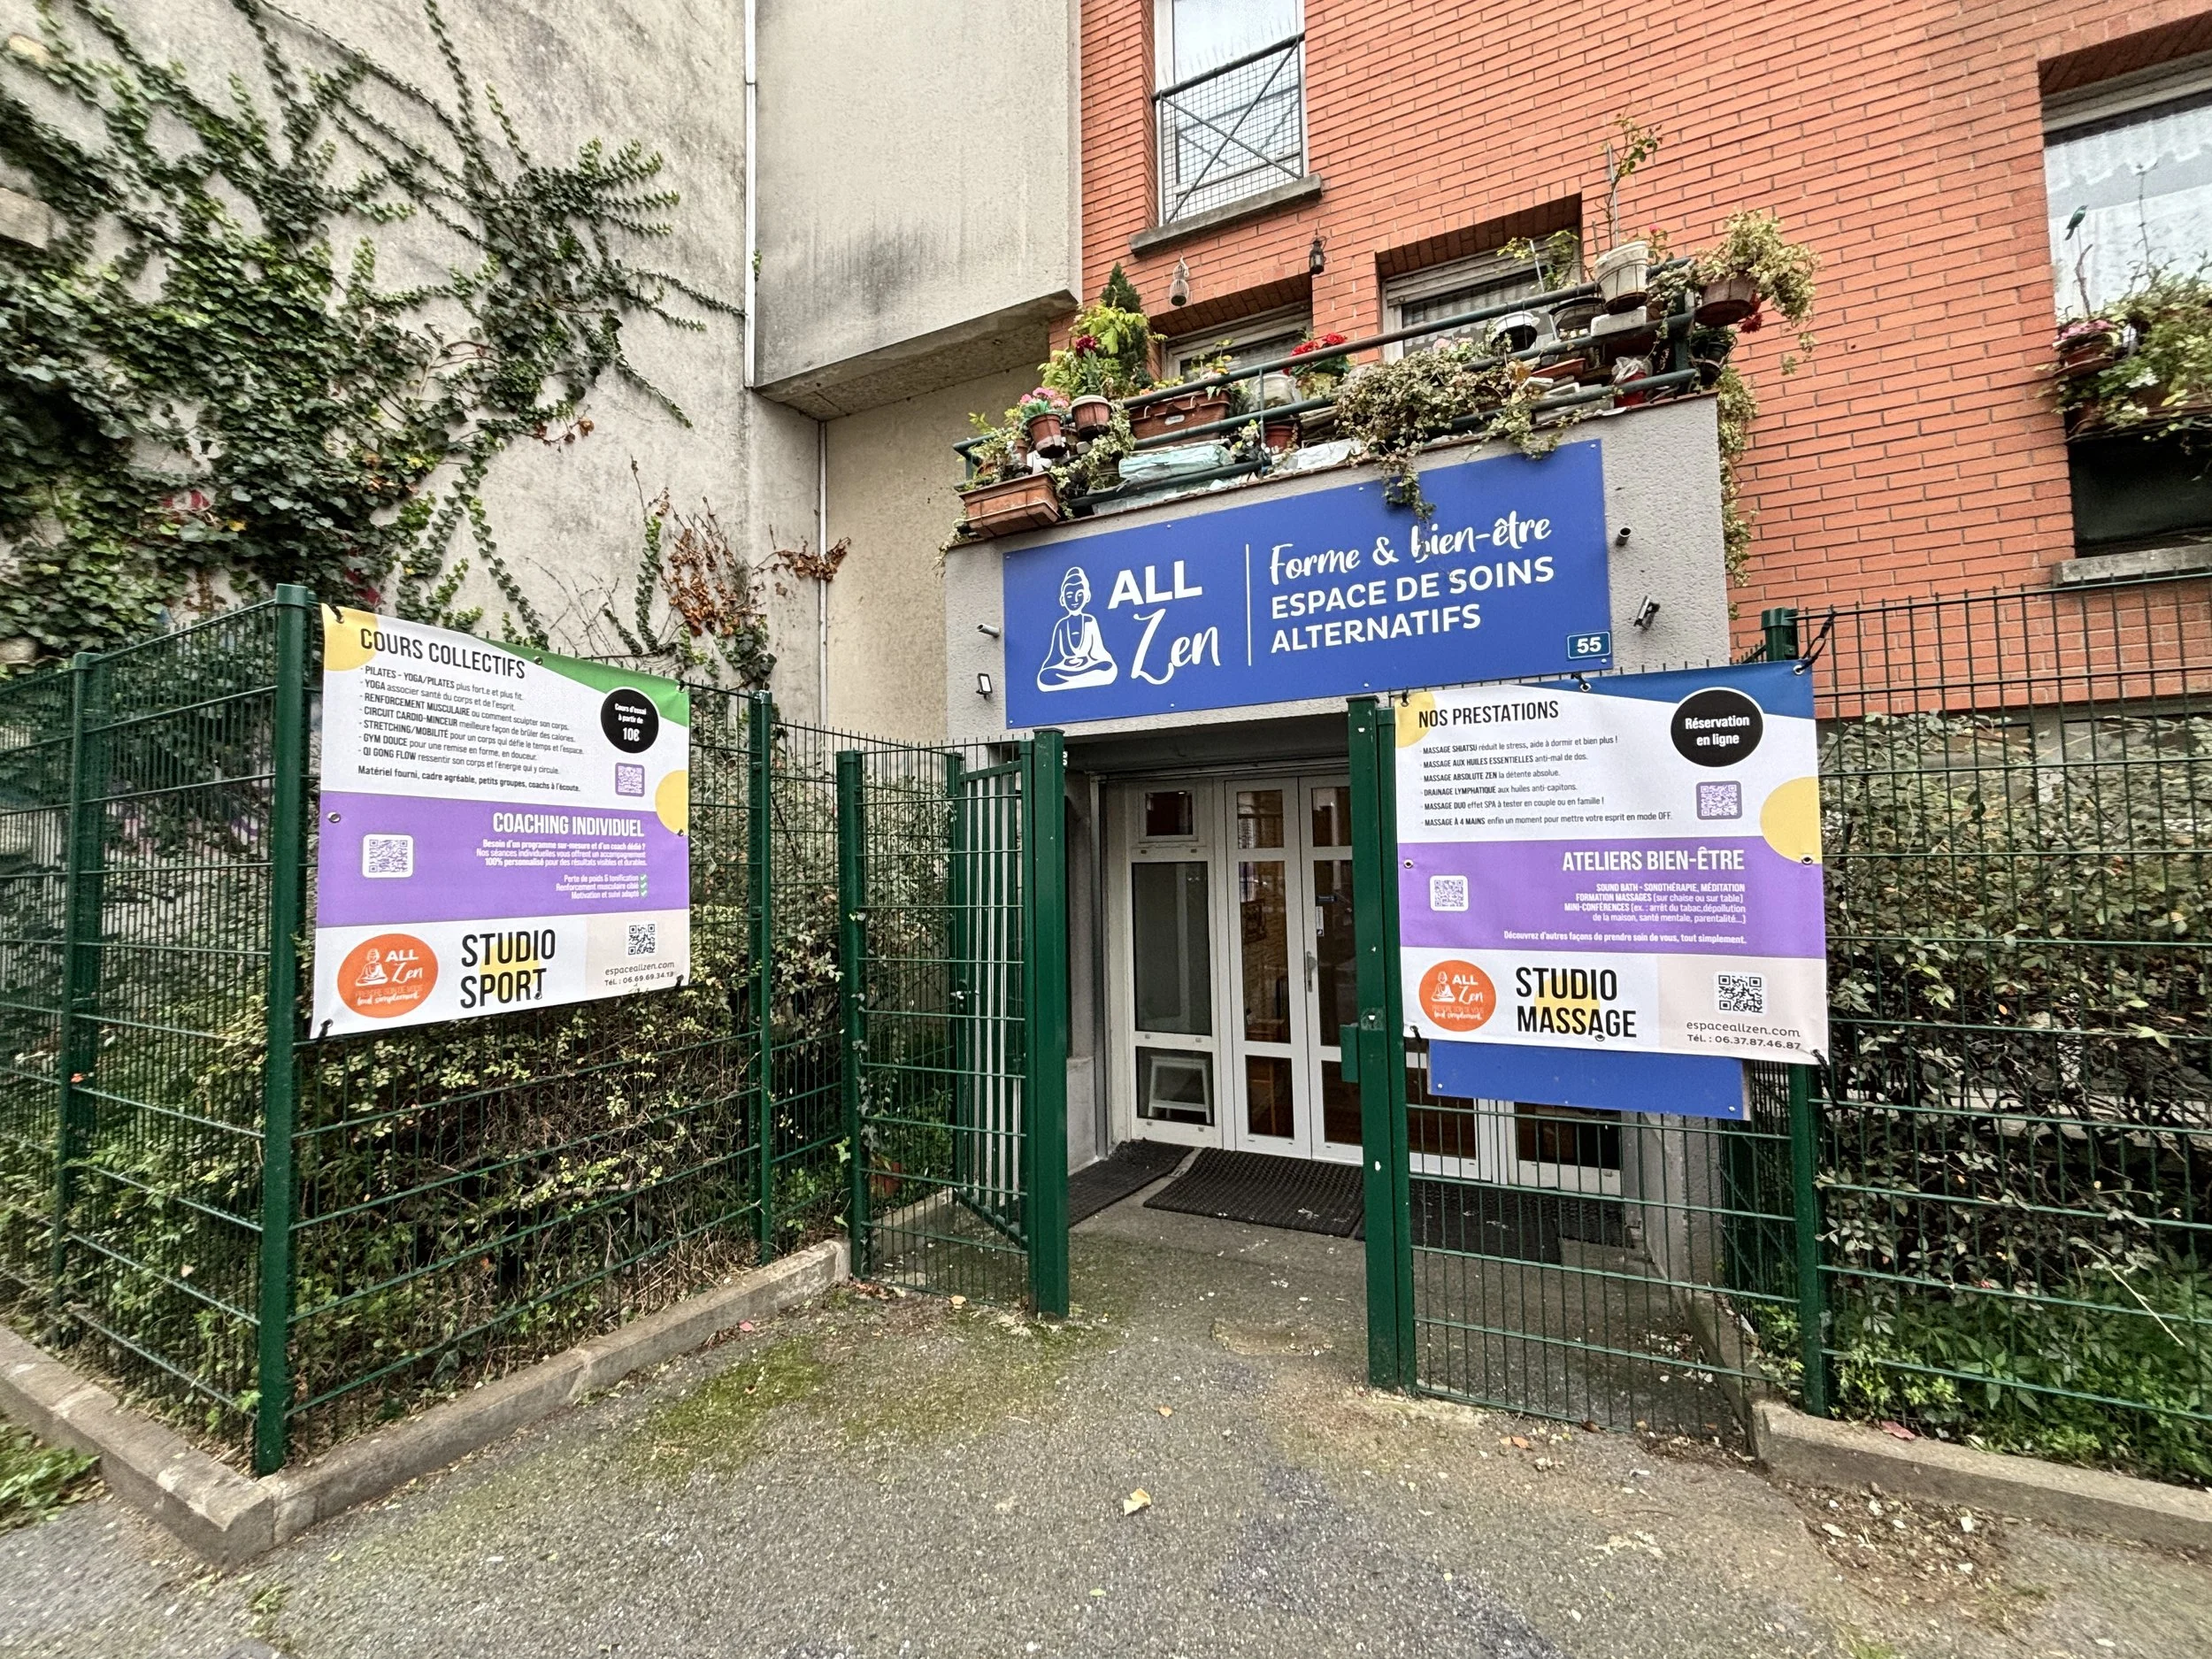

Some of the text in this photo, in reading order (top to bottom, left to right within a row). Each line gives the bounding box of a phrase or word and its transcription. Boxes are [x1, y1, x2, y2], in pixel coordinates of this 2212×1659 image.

[1270, 510, 1551, 586] Forme & bien-être
[1108, 559, 1202, 611] ALL
[1271, 557, 1554, 618] ESPACE DE SOINS
[1271, 603, 1481, 655] ALTERNATIFS
[360, 628, 526, 679] COURS COLLECTIFS
[1132, 607, 1219, 686] Zen
[1577, 637, 1602, 655] 55
[365, 665, 396, 679] PILATES
[403, 672, 455, 688] YOGA/PILATES
[456, 683, 470, 692] plus
[364, 693, 424, 709] RENFORCEMENT
[426, 703, 470, 716] MUSCULAIRE
[480, 712, 511, 722] comment
[512, 717, 538, 726] sculpter
[1418, 701, 1558, 727] NOS PRESTATIONS
[1685, 716, 1750, 729] Réservation
[1423, 745, 1450, 754] MASSAGE
[1599, 736, 1614, 745] plus
[1696, 734, 1740, 747] en ligne
[1423, 759, 1451, 768] MASSAGE
[1488, 755, 1533, 764] ESSENTIELLES
[357, 765, 392, 776] Matériel
[394, 768, 419, 780] fourni,
[443, 774, 477, 784] agréable,
[1423, 773, 1451, 782] MASSAGE
[1453, 772, 1483, 780] ABSOLUTE
[1424, 787, 1453, 796] DRAINAGE
[1454, 786, 1496, 795] LYMPHATIQUE
[1424, 802, 1452, 810] MASSAGE
[1577, 796, 1600, 805] famille
[493, 813, 645, 836] COACHING INDIVIDUEL
[1424, 818, 1452, 826] MASSAGE
[1604, 813, 1624, 822] esprit
[1562, 847, 1745, 871] ATELIERS BIEN-ÊTRE
[1595, 883, 1619, 892] SOUND
[1619, 883, 1638, 892] BATH
[1643, 883, 1699, 892] SONOTHÉRAPIE,
[1700, 883, 1745, 892] MÉDITATION
[1575, 893, 1614, 902] FORMATION
[1615, 893, 1652, 902] MASSAGES
[1563, 902, 1630, 911] MINI-CONFÉRENCES
[1669, 903, 1678, 912] du
[1602, 913, 1609, 922] la
[1638, 913, 1659, 922] santé
[1503, 931, 1539, 940] Découvrez
[1540, 931, 1568, 941] d'autres
[1568, 932, 1593, 941] façons
[1593, 932, 1602, 941] de
[1603, 933, 1632, 941] prendre
[1632, 933, 1648, 941] soin
[1648, 933, 1658, 941] de
[1680, 933, 1697, 942] tout
[1698, 934, 1747, 943] simplement.
[385, 949, 419, 963] ALL
[461, 930, 556, 966] STUDIO
[392, 961, 423, 985] Zen
[1452, 973, 1479, 987] ALL
[459, 968, 547, 1009] SPORT
[1515, 967, 1617, 1000] STUDIO
[1458, 986, 1484, 1006] Zen
[1517, 1006, 1637, 1037] MASSAGE
[1686, 1022, 1801, 1037] espaceallzen.com
[1715, 1035, 1801, 1049] 06.37.87.46.87
